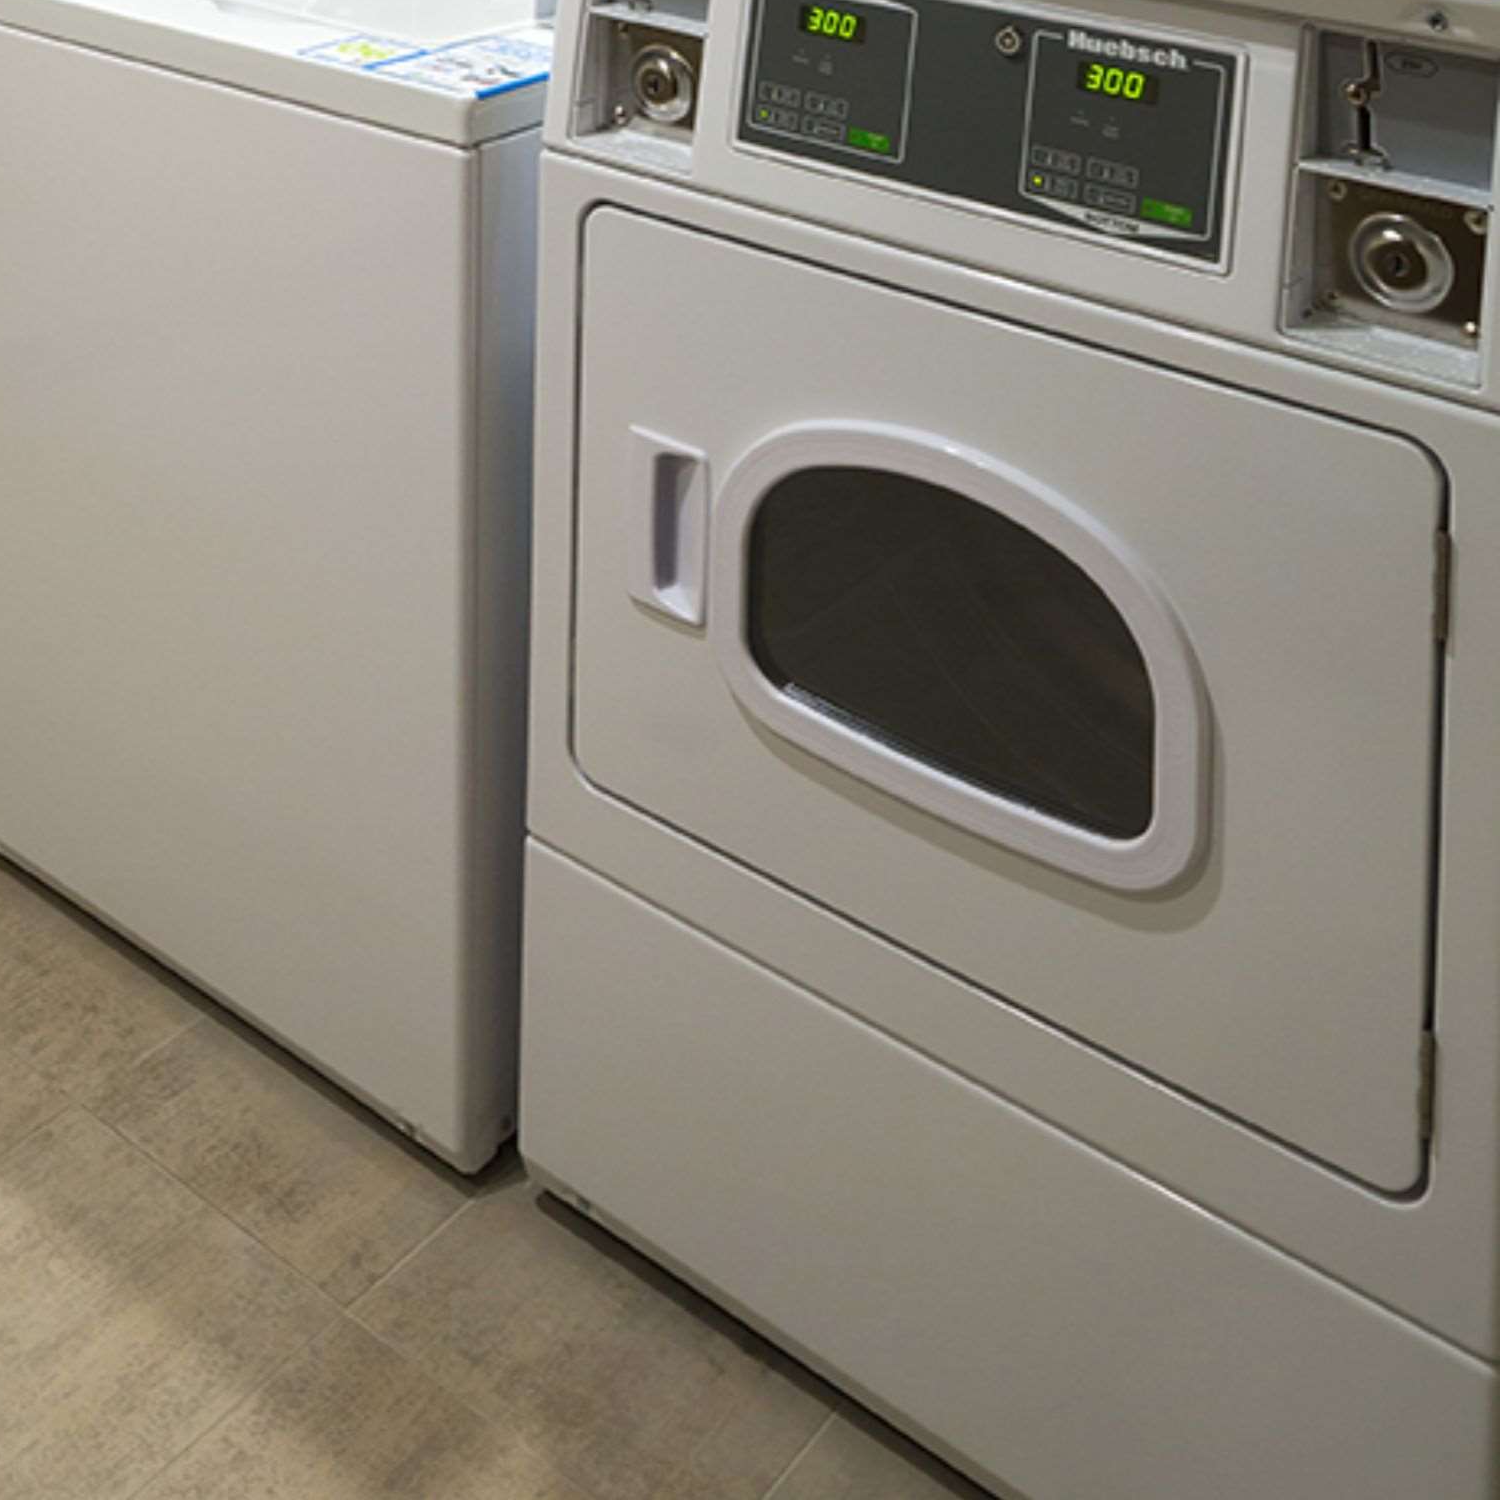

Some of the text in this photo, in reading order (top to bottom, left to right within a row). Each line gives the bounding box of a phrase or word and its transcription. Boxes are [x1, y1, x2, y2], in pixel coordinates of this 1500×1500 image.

[806, 5, 858, 41] 300
[1066, 27, 1189, 72] Huebsch
[1084, 63, 1146, 101] 300
